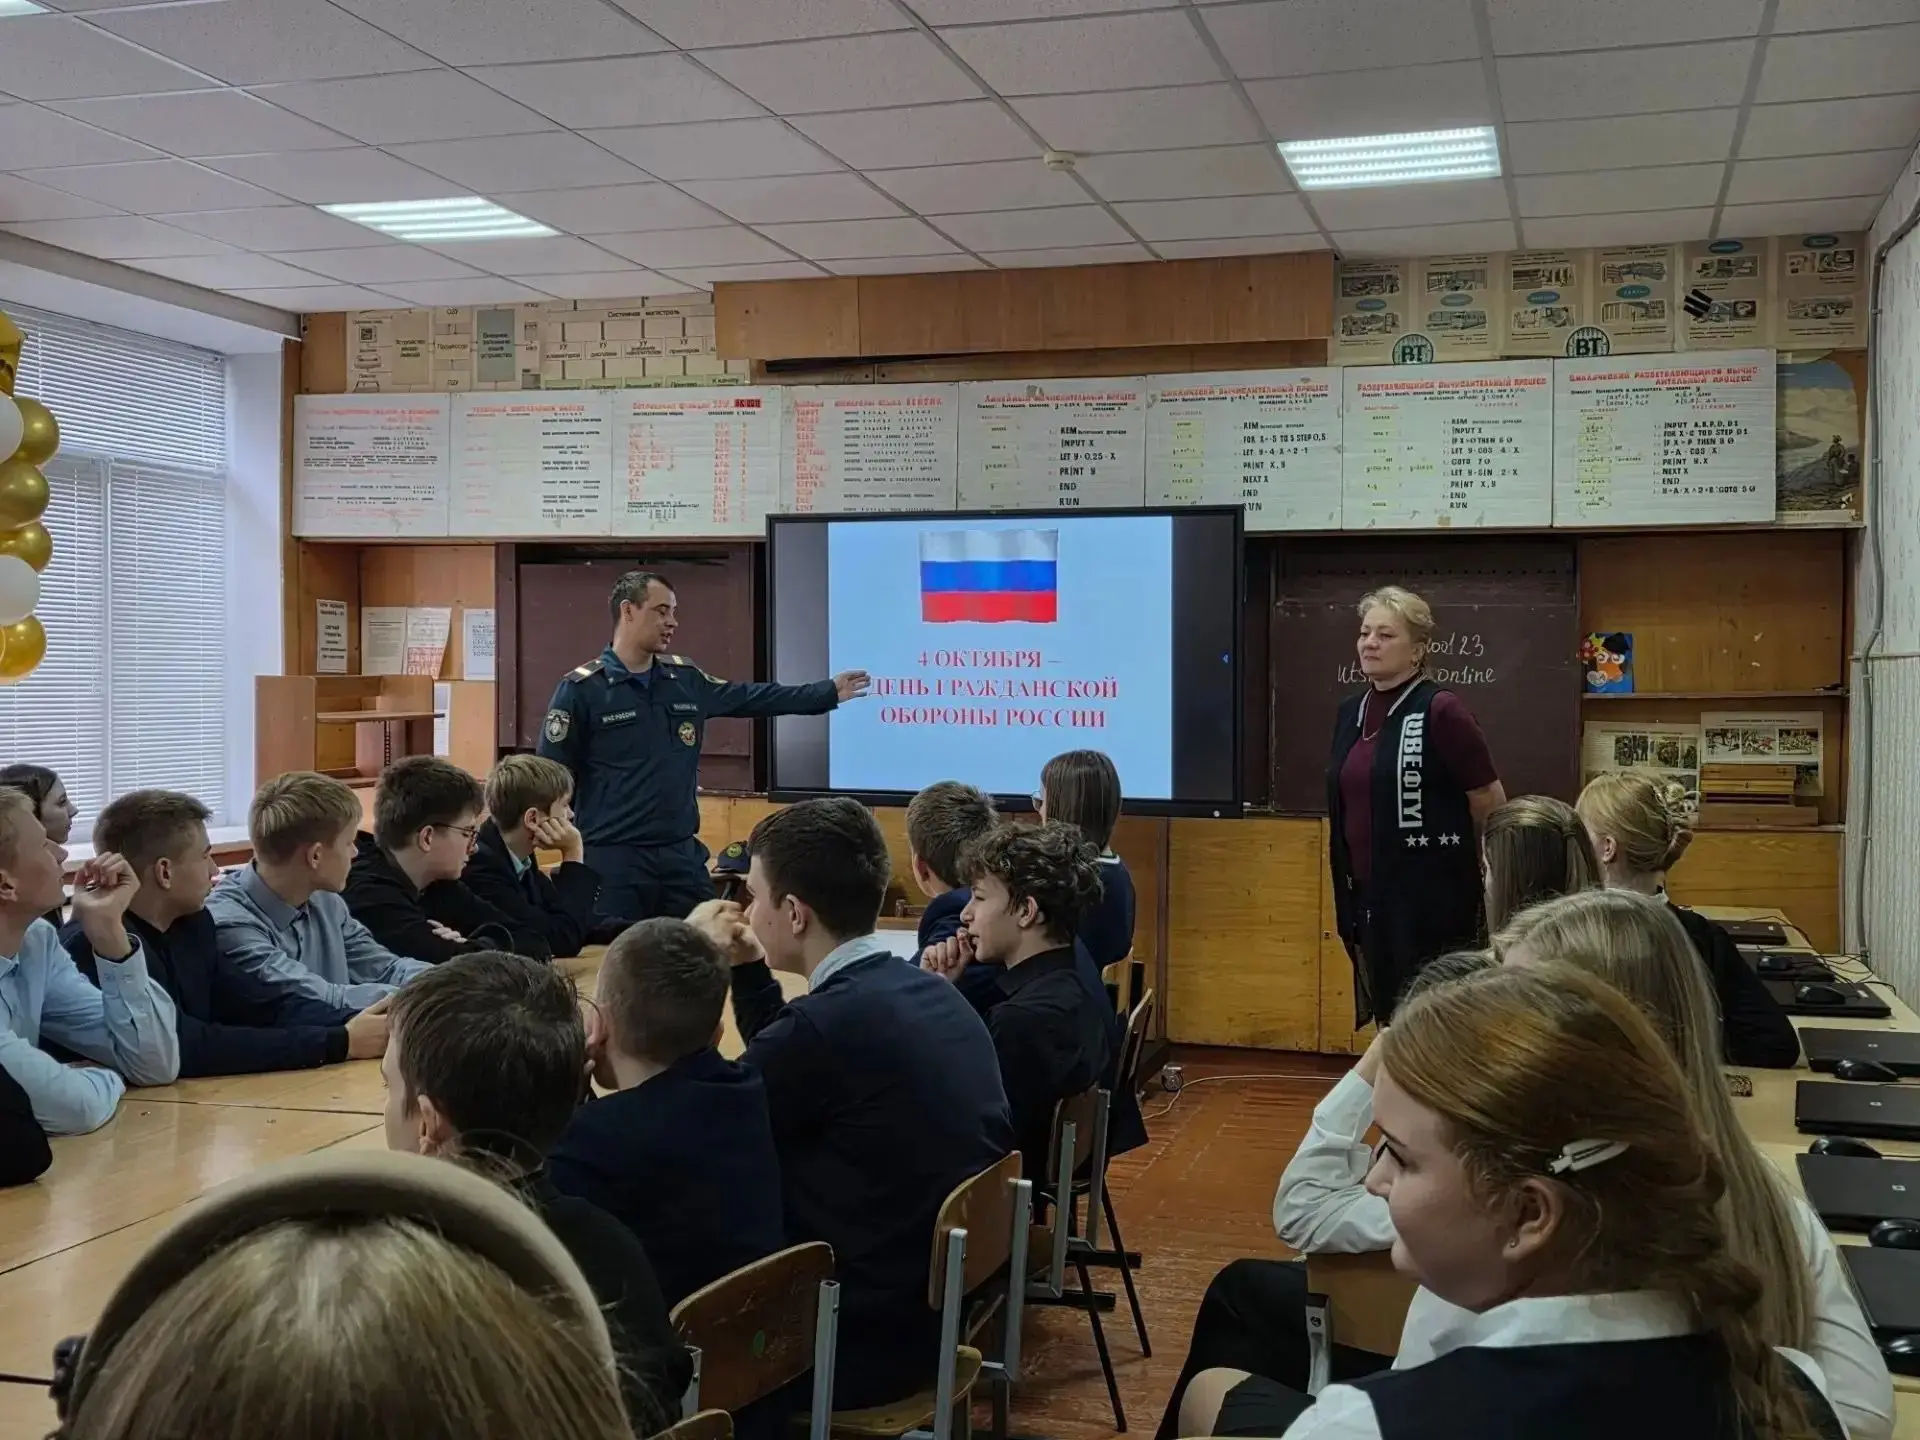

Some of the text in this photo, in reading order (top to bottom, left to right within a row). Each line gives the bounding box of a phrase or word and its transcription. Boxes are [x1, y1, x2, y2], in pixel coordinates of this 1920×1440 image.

[1715, 428, 1733, 436] STEP
[1243, 436, 1256, 444] FOR
[1296, 434, 1312, 442] STEP
[1060, 439, 1085, 448] INPUT
[1242, 448, 1253, 456] LET
[1060, 452, 1071, 461] LET
[1243, 461, 1264, 469] PRINT
[1662, 458, 1687, 466] PRINT
[1059, 467, 1084, 476] PRINT
[1450, 469, 1463, 477] LET
[1662, 467, 1681, 475] NEXT
[1242, 475, 1262, 483] NEXT
[1662, 477, 1680, 485] END
[1059, 483, 1077, 491] END
[1450, 480, 1474, 488] PRINT
[1242, 488, 1258, 497] END
[1059, 498, 1080, 506] RUN
[1460, 633, 1484, 657] 23
[917, 651, 929, 667] 4
[934, 650, 1042, 668] ОКТЯБРЯ
[1437, 665, 1497, 685] online
[870, 675, 1120, 700] ДЕНЬ ГРАЖДАНСКОЙ
[880, 705, 1106, 728] ОБОРОНЫ РОССИИ
